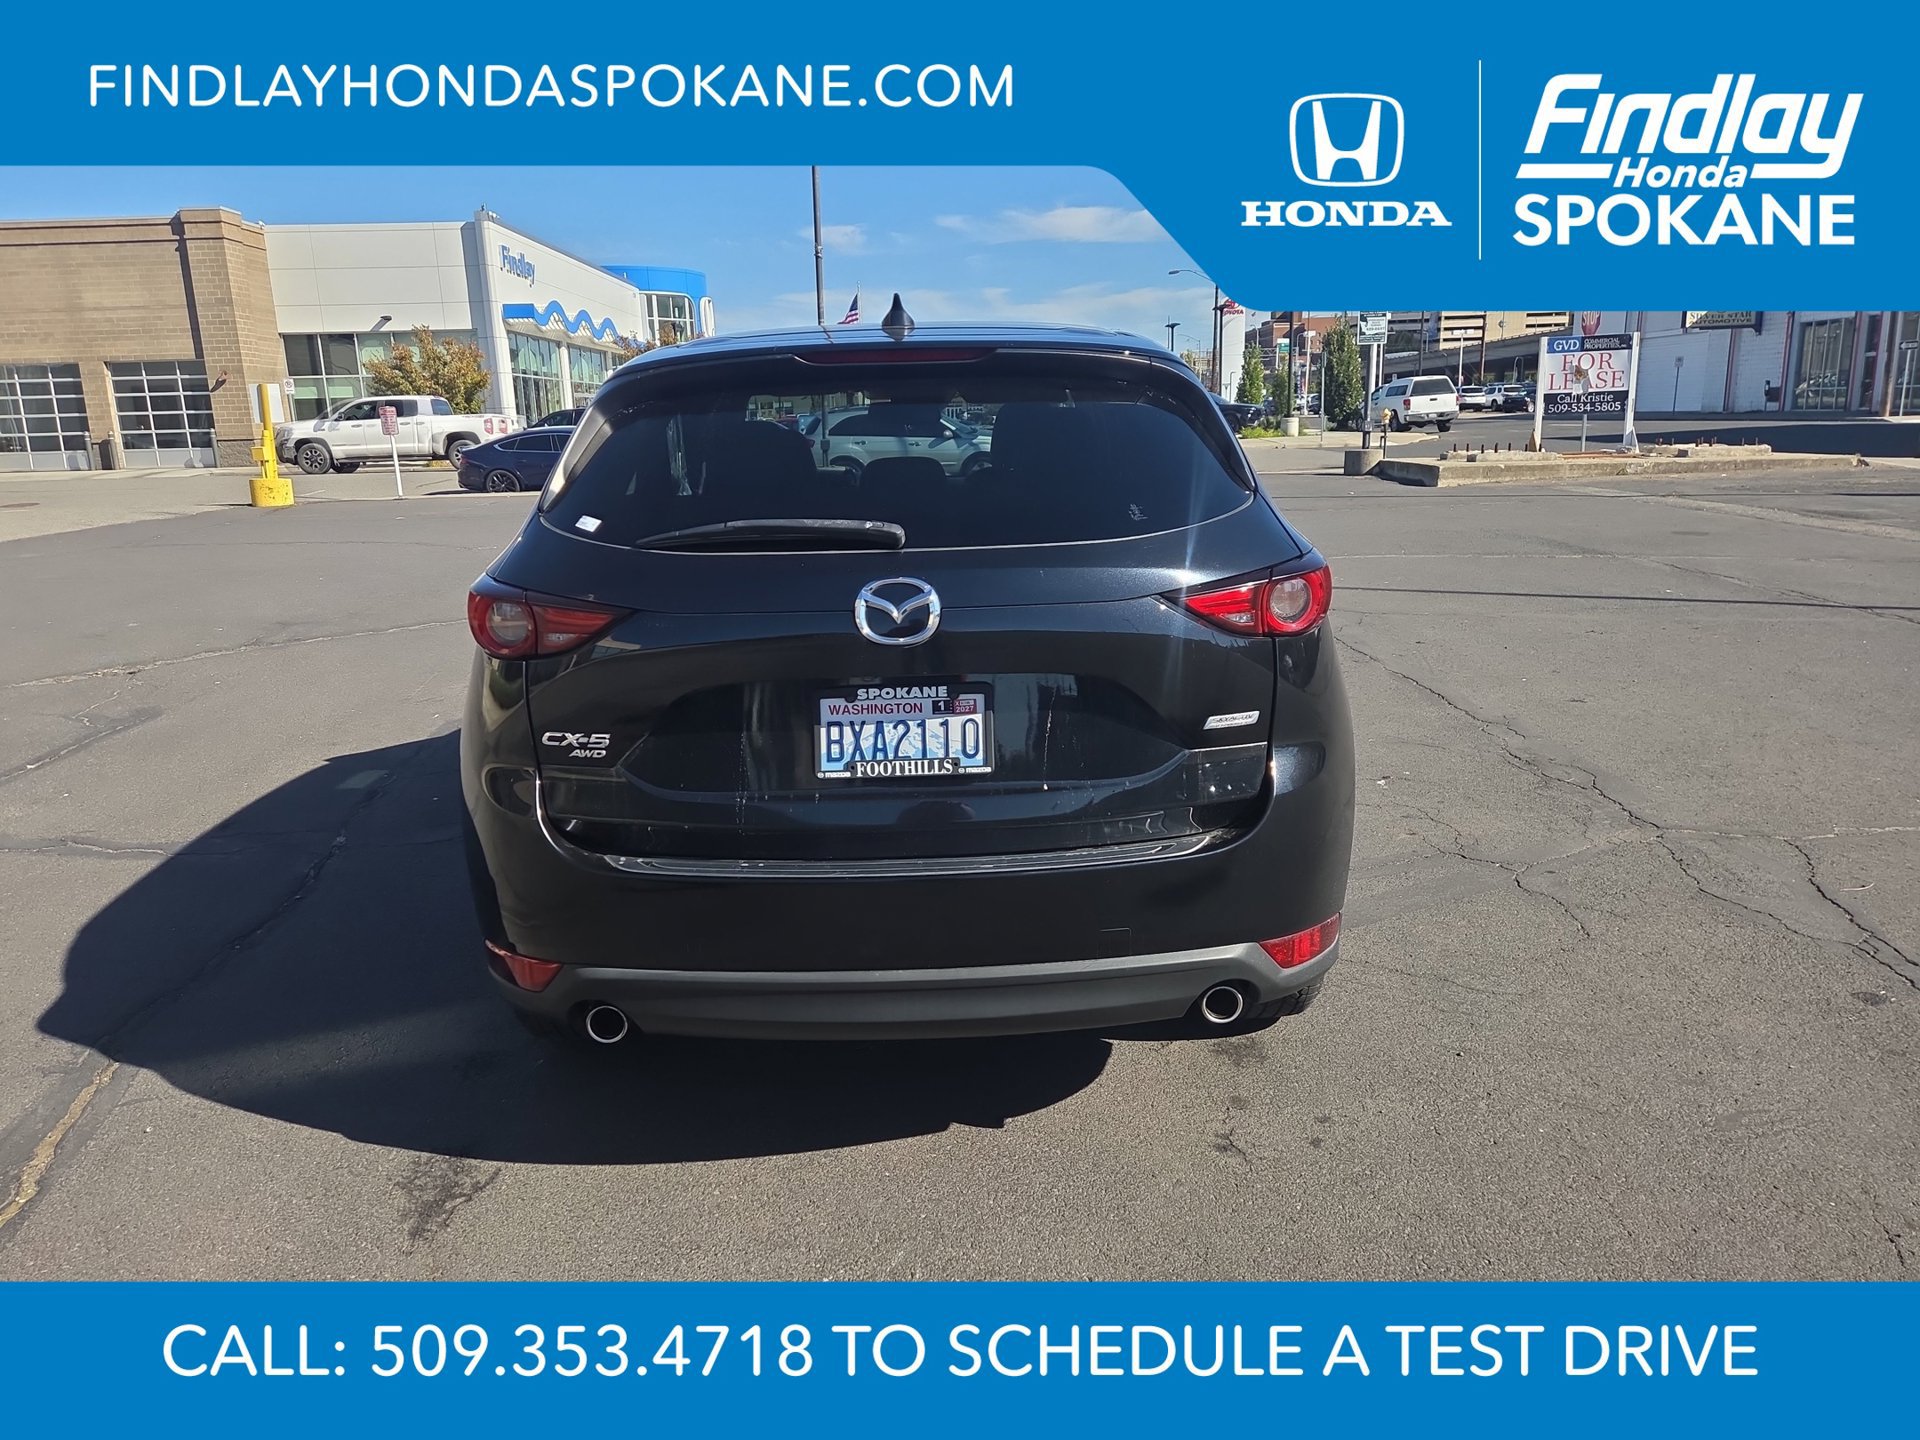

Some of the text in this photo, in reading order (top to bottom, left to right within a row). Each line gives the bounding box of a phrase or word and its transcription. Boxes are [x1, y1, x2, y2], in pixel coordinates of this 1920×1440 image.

[498, 244, 536, 285] Findlay
[1582, 311, 1600, 326] STOP
[1553, 339, 1579, 351] GVD
[1561, 352, 1614, 372] FOR
[1557, 393, 1614, 404] Call Kristie
[1548, 401, 1621, 413] 509-534-5805
[857, 685, 948, 700] SPOKANE
[828, 702, 923, 716] WASHINGTON
[955, 705, 974, 713] 2027
[541, 731, 611, 748] CX-5
[826, 717, 980, 763] BXA2110
[568, 749, 607, 758] AWD
[855, 758, 954, 777] FOOTHILLS
